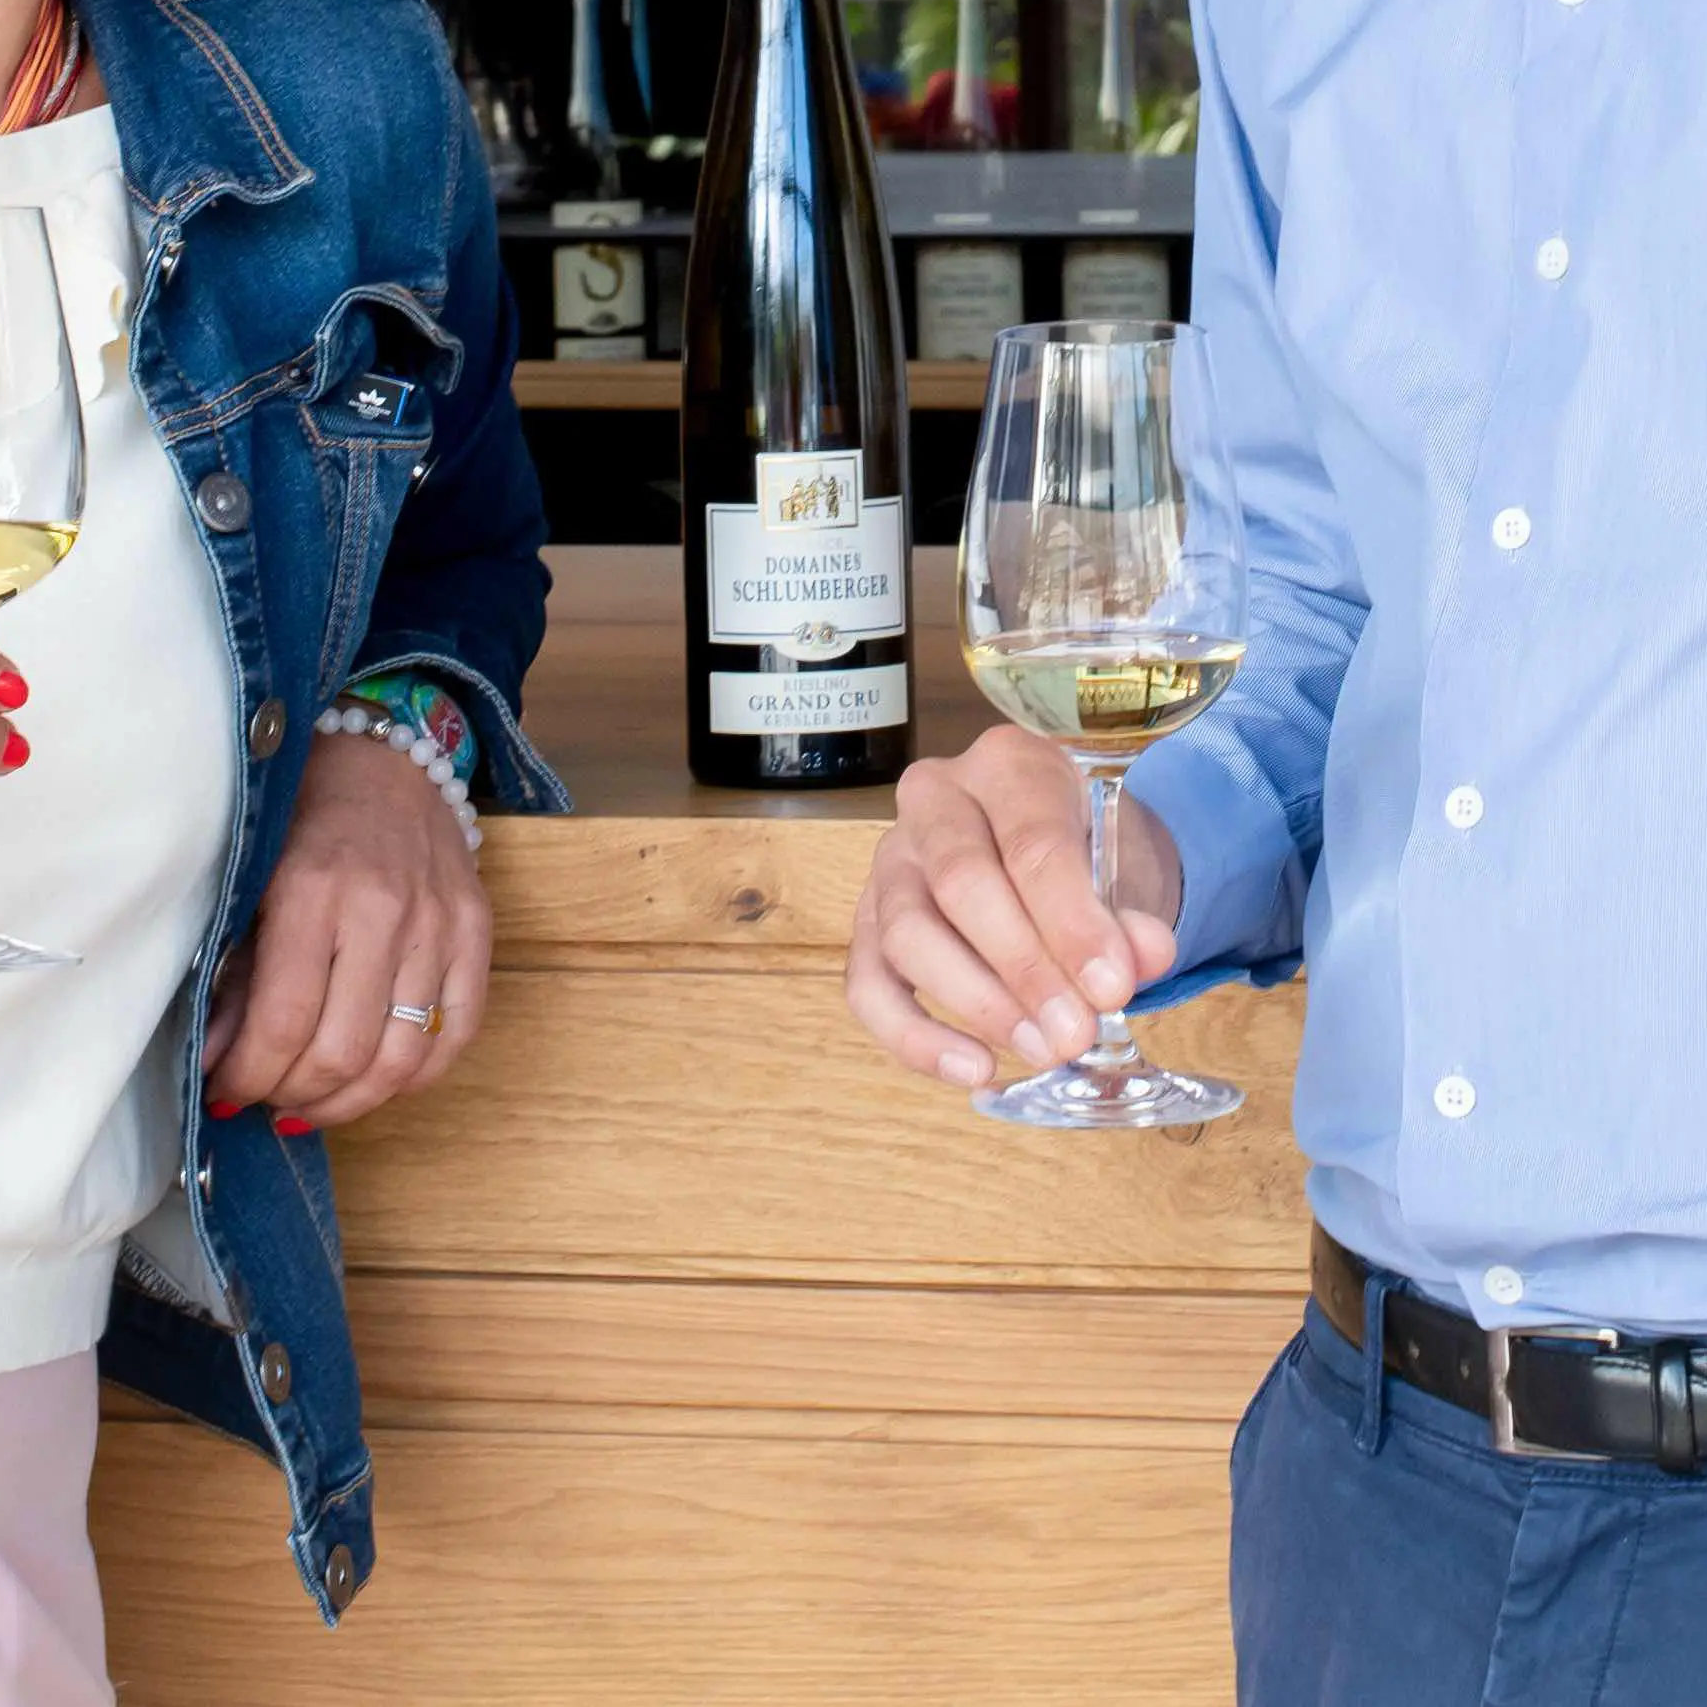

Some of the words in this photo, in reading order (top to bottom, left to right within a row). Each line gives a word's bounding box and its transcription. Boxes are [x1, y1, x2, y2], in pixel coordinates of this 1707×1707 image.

[765, 552, 862, 575] DOMAINES
[731, 574, 891, 604] SCHLUMBERGER
[782, 675, 851, 694] RIESLING
[748, 692, 832, 713] GRAND
[838, 689, 881, 709] CRU
[762, 713, 832, 727] KESSLER
